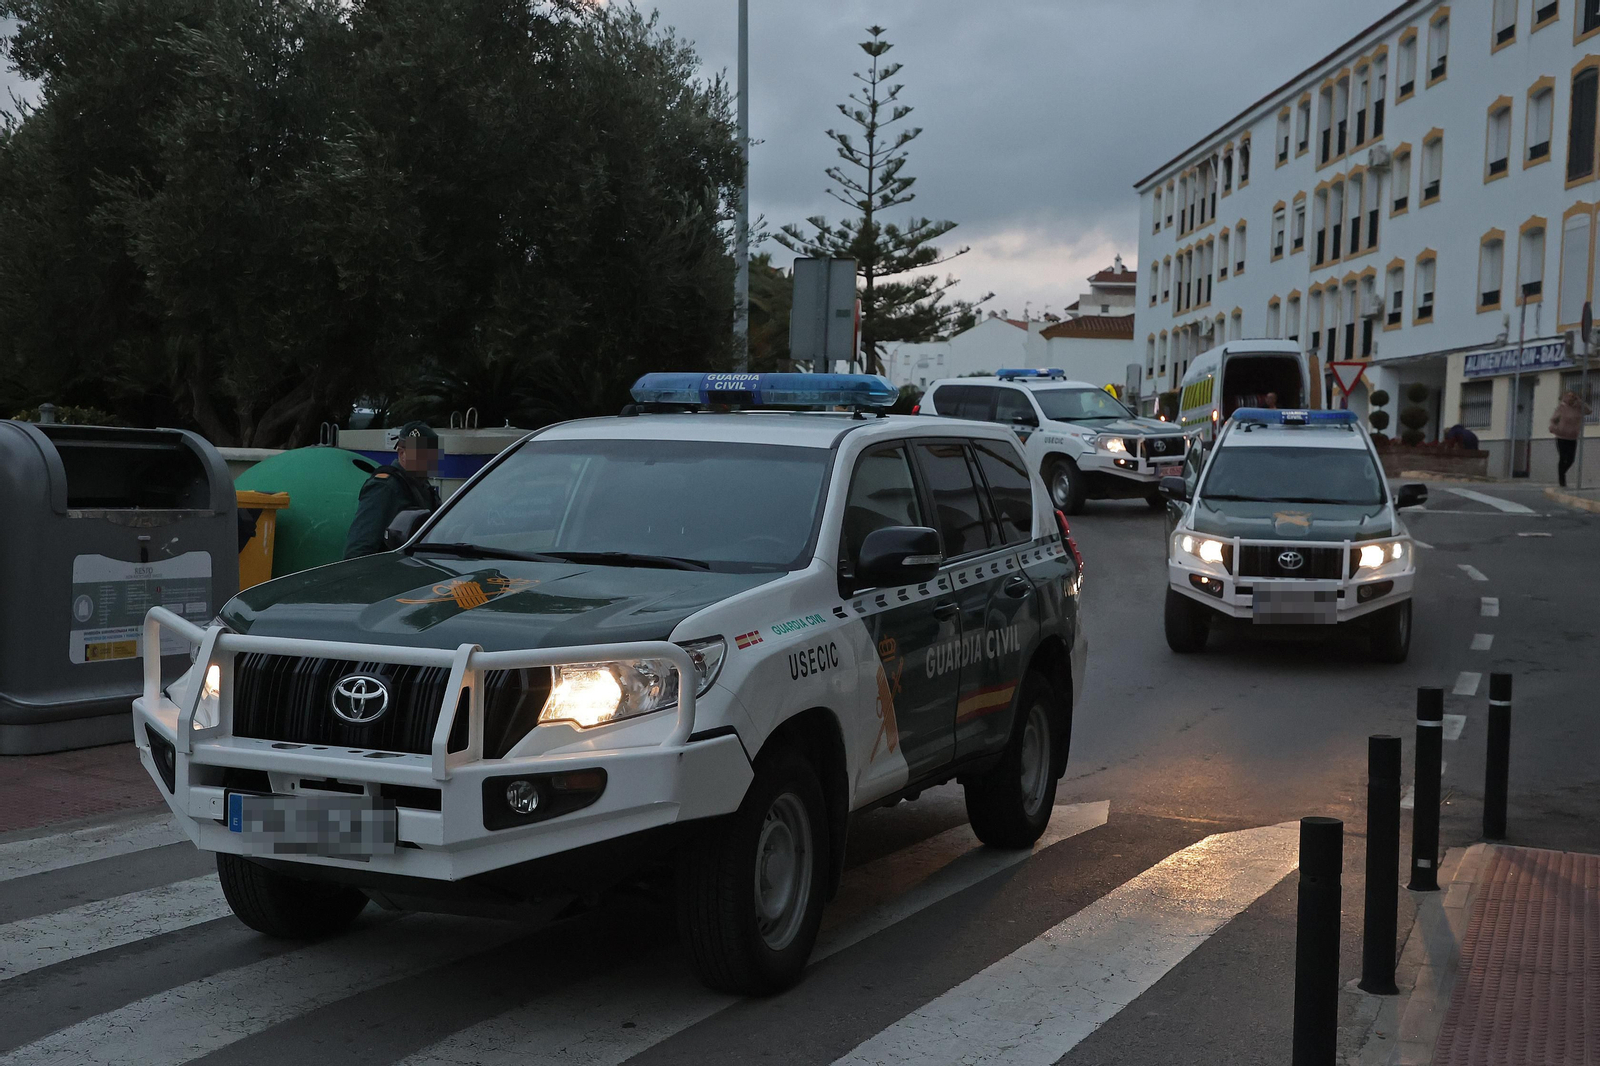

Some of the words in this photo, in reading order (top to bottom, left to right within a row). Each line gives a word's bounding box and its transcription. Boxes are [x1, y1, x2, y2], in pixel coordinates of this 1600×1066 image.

[714, 381, 746, 390] CIVIL
[771, 618, 809, 635] GUARDIA
[805, 613, 827, 626] CIVIL
[788, 641, 839, 681] USECIC
[925, 633, 982, 679] GUARDIA
[986, 624, 1021, 659] CIVIL
[232, 817, 239, 826] E
